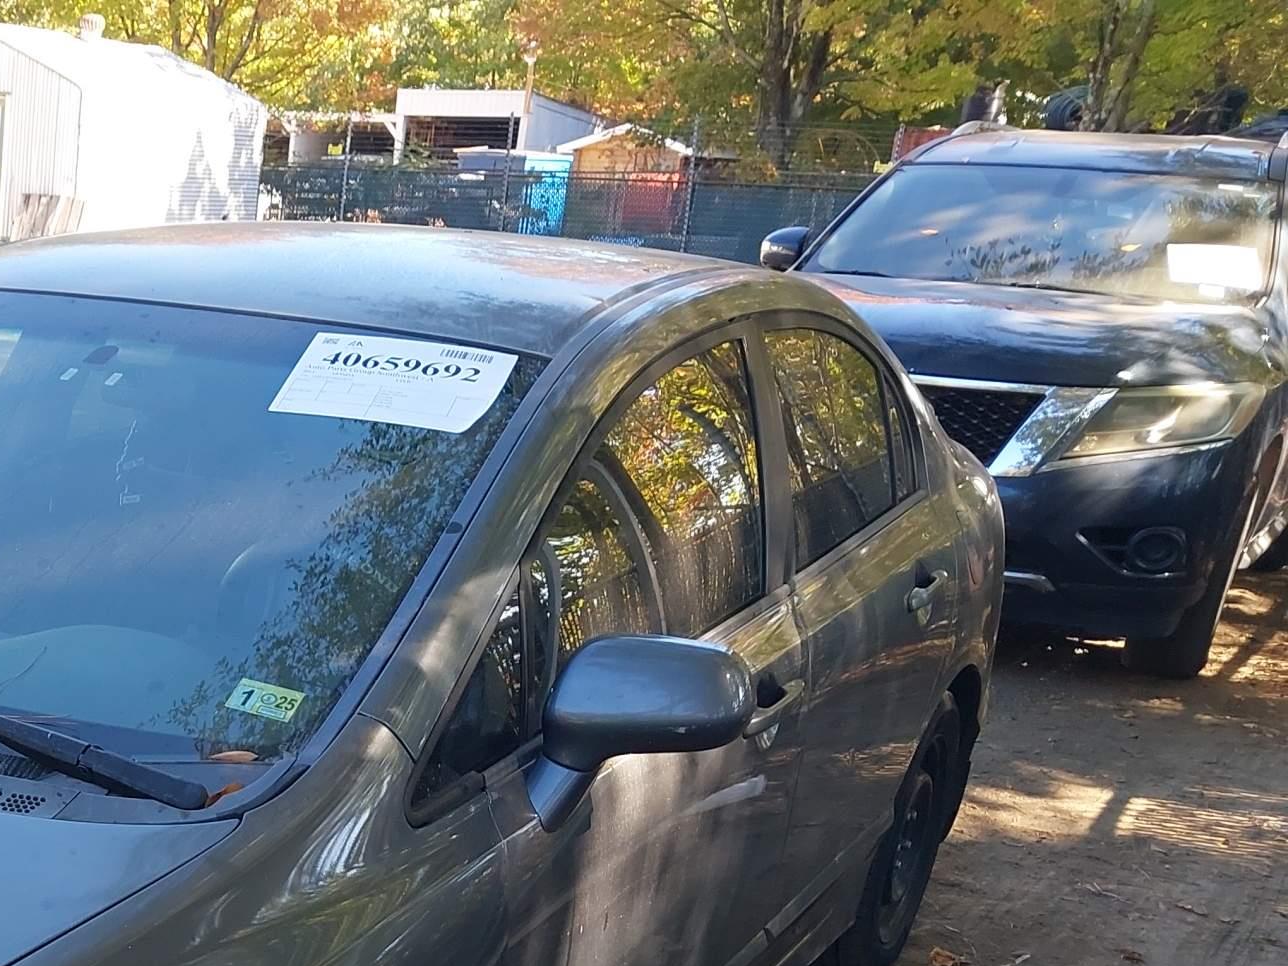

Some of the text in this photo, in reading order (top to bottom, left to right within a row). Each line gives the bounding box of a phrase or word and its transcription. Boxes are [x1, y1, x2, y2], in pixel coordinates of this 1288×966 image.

[322, 351, 481, 383] 40659692
[242, 689, 298, 711] 1 25
